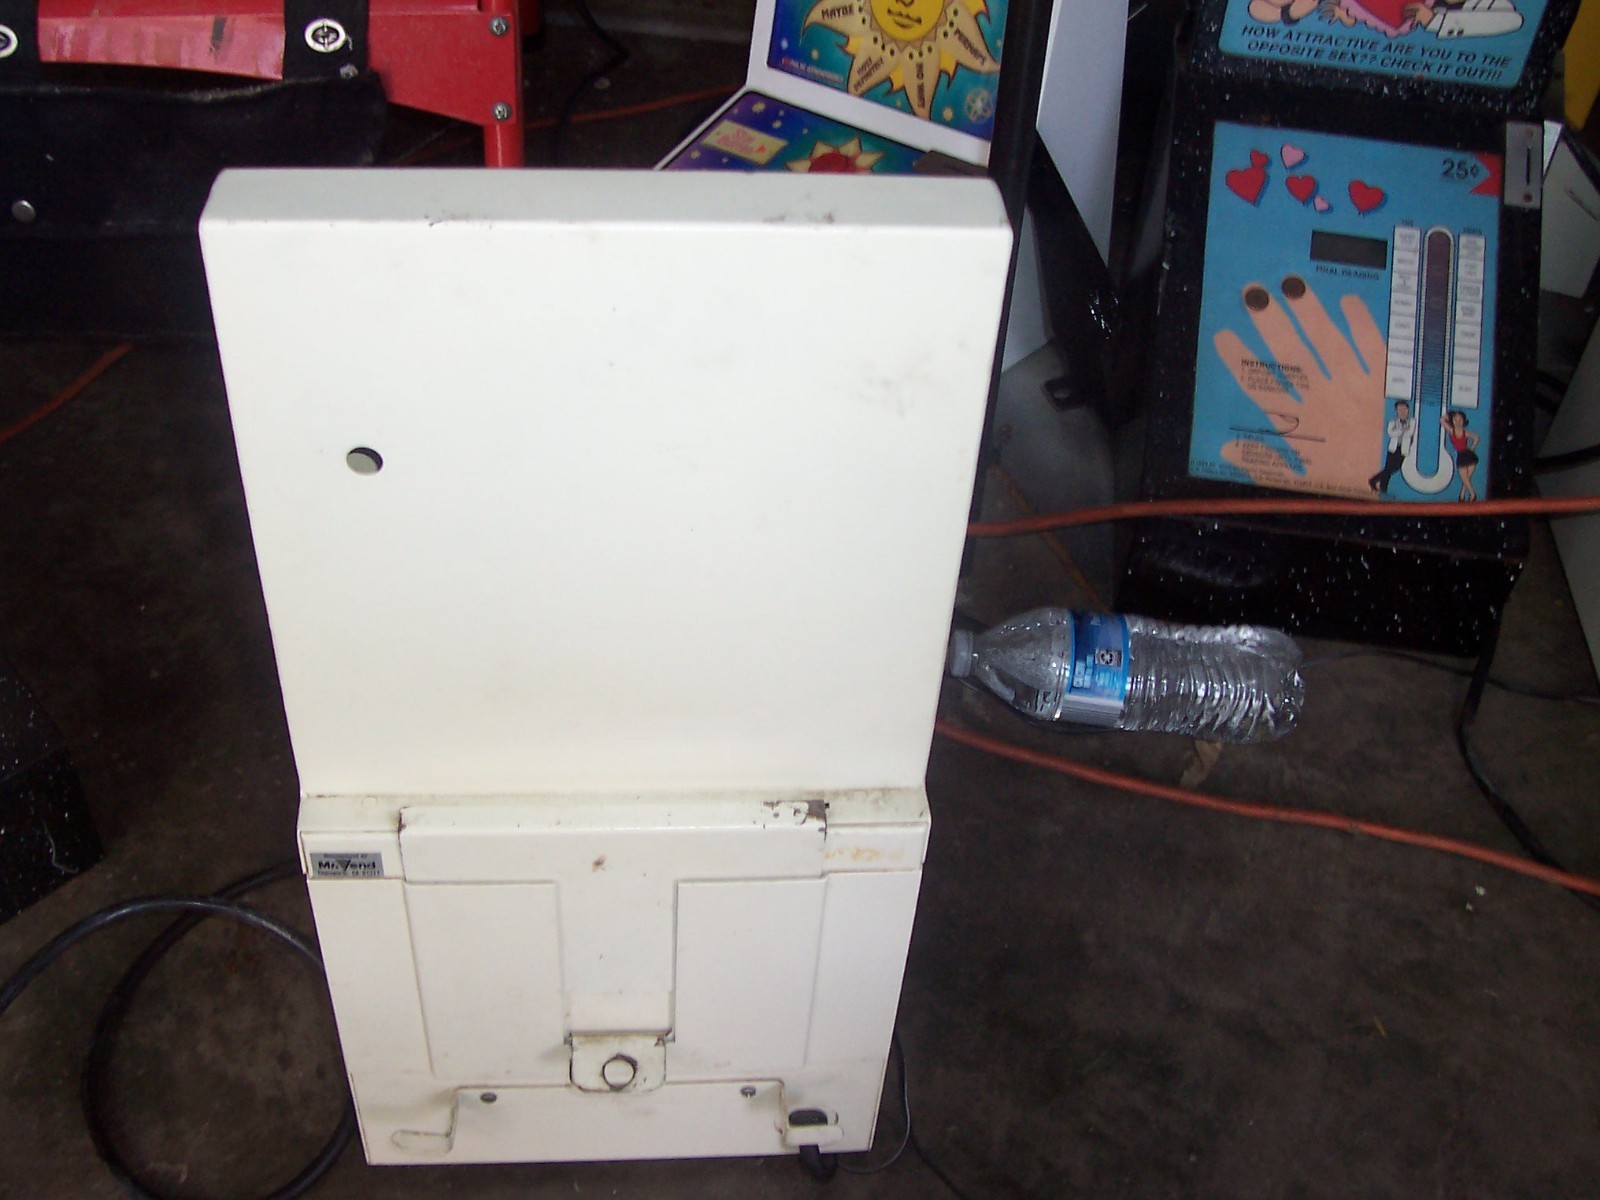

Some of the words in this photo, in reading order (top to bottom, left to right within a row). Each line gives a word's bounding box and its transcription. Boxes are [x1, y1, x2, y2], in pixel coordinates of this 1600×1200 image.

[1242, 24, 1279, 38] HOW
[1284, 29, 1379, 51] ATTRACTIVE
[1381, 41, 1415, 55] ARE
[1420, 46, 1452, 60] YOU
[1457, 51, 1477, 63] TO
[1481, 54, 1511, 68] THE
[1248, 40, 1324, 58] OPPOSITE
[1380, 57, 1433, 73] CHECK
[1436, 62, 1451, 75] IT
[1442, 158, 1479, 180] 25¢
